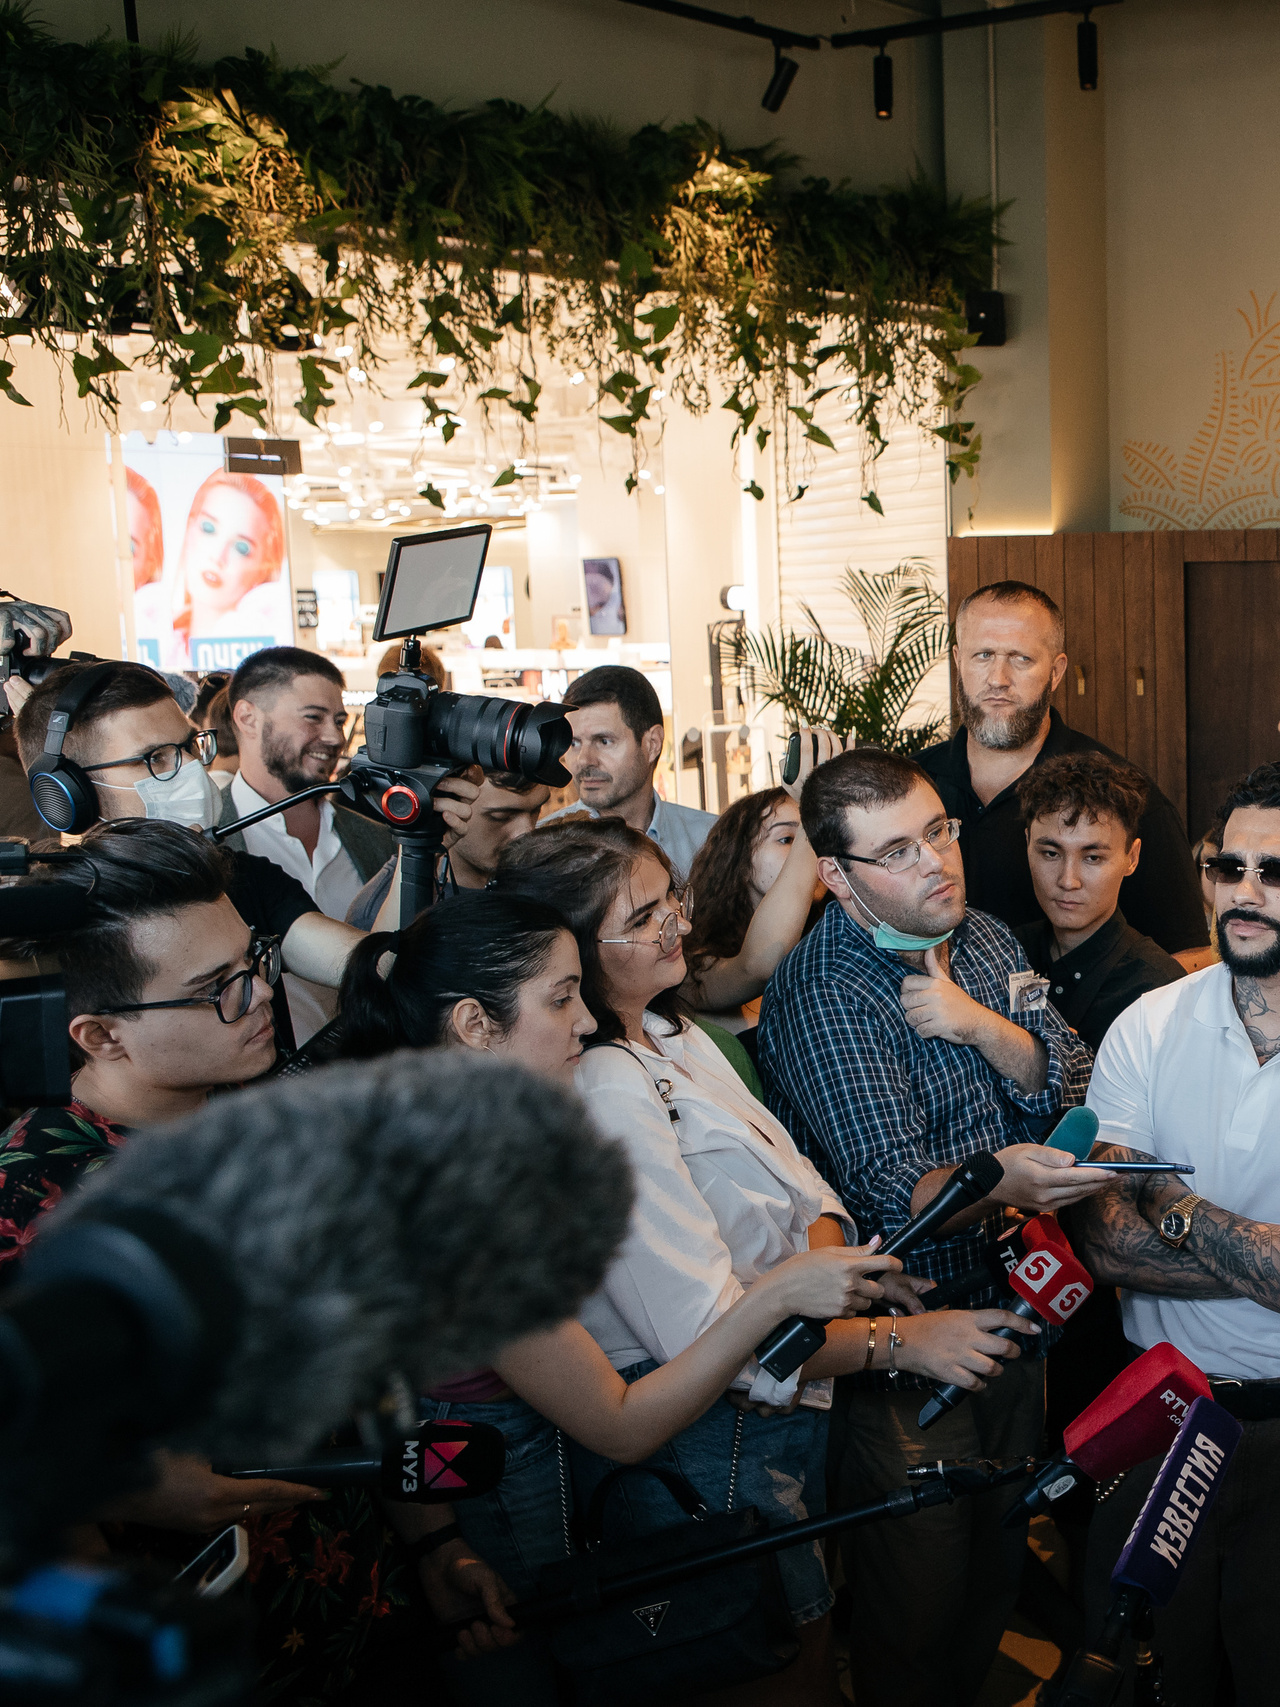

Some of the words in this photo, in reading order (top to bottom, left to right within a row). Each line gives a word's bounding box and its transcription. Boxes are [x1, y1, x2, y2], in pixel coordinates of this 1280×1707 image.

[197, 642, 264, 670] ОЧЕ
[1024, 1256, 1052, 1282] 5
[1059, 1288, 1083, 1312] 5
[1167, 1414, 1184, 1427] .co
[402, 1441, 420, 1493] МУЗ
[1150, 1432, 1225, 1569] ИЗВЕСТИЯ
